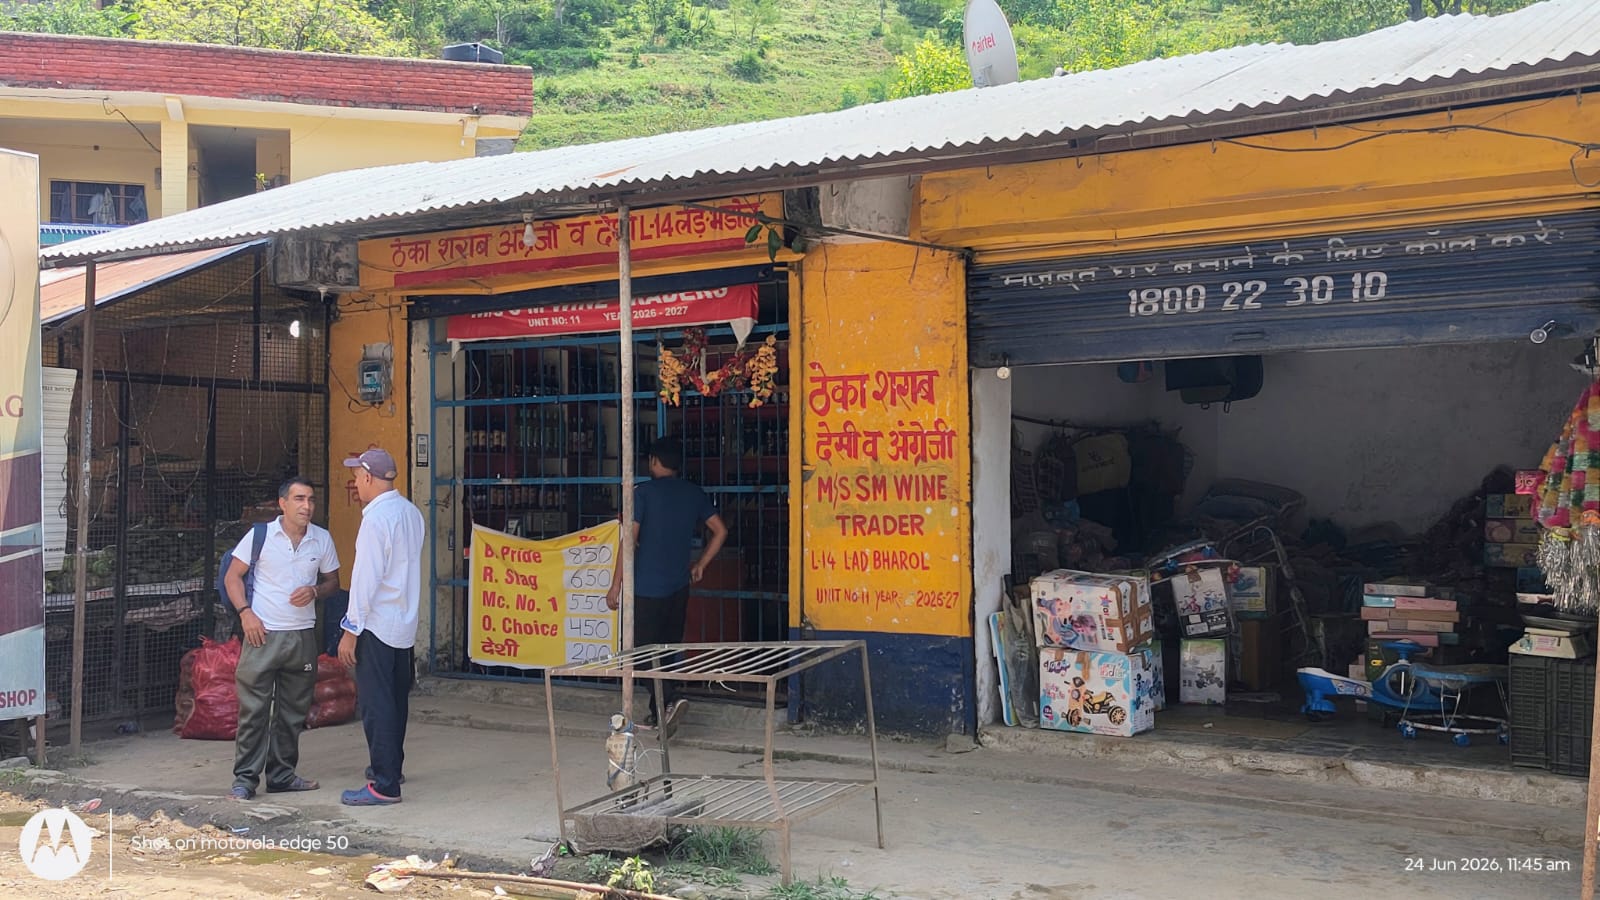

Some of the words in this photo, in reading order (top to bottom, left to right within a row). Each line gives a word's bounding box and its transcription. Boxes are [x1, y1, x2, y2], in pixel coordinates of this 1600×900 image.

[976, 33, 996, 53] airtel
[438, 233, 493, 262] शराब
[566, 220, 591, 247] व
[1128, 283, 1206, 318] 1800
[1221, 280, 1268, 312] 22
[1283, 275, 1334, 307] 30
[1351, 271, 1388, 303] 10
[528, 317, 549, 328] UNIT
[552, 317, 568, 326] NO:
[570, 315, 581, 325] 11
[603, 311, 621, 322] YEA
[632, 308, 657, 319] 2026
[664, 306, 688, 317] 2027
[808, 361, 870, 417] ठेका
[862, 430, 884, 462] व
[887, 418, 958, 467] अंग्रेजी
[855, 474, 888, 502] SM
[893, 474, 948, 502] WINE
[835, 514, 925, 537] TRADER
[501, 546, 542, 564] Pride
[568, 545, 612, 565] 850
[844, 550, 869, 572] LAD
[873, 550, 930, 572] BHAROL
[483, 566, 498, 583] R.
[505, 568, 538, 591] Stag
[570, 568, 611, 589] 650
[482, 590, 510, 609] Mc.
[516, 594, 541, 613] No.
[547, 597, 559, 613] 1
[816, 588, 841, 605] UNIT
[502, 617, 559, 637] Choice
[570, 617, 610, 639] 450
[480, 636, 520, 658] देशी
[0, 688, 37, 709] SHOP
